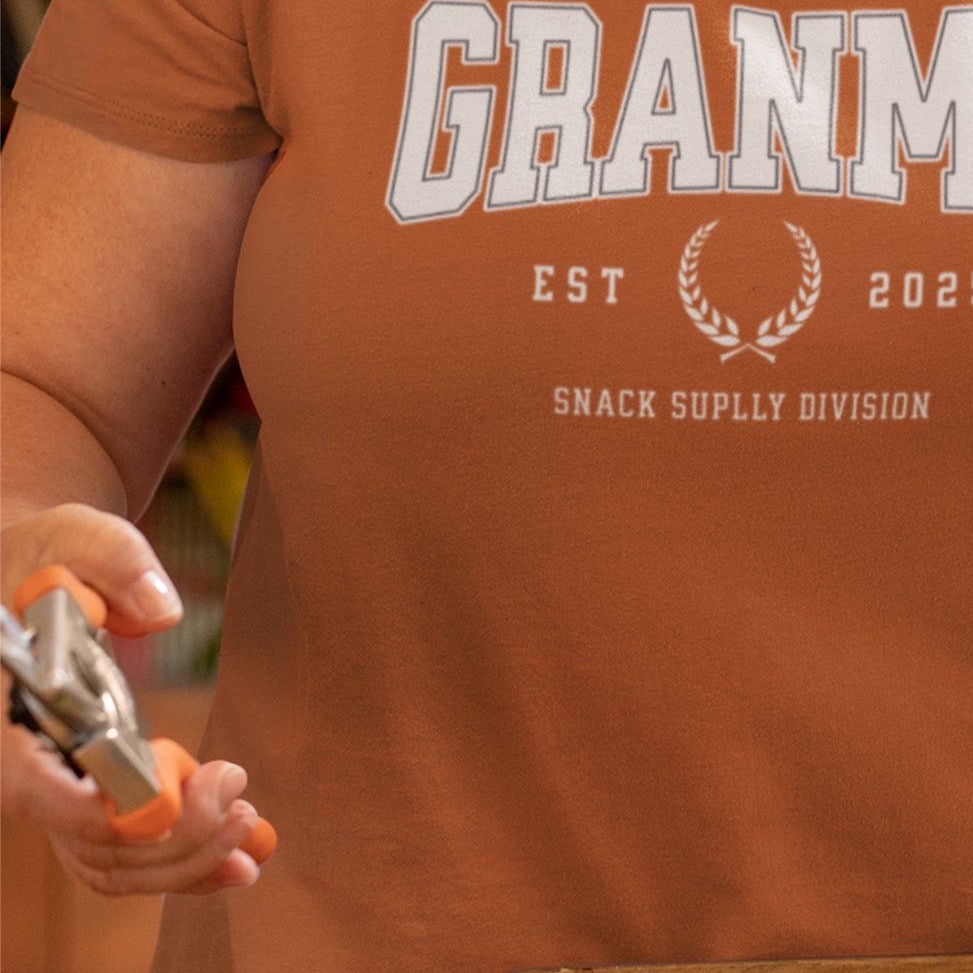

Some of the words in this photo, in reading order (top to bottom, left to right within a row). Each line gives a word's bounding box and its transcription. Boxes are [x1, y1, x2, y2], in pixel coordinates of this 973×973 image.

[532, 265, 624, 304] EST
[555, 387, 655, 418] SNACK
[671, 391, 785, 420] SUPLLY
[800, 392, 930, 420] DIVISION
